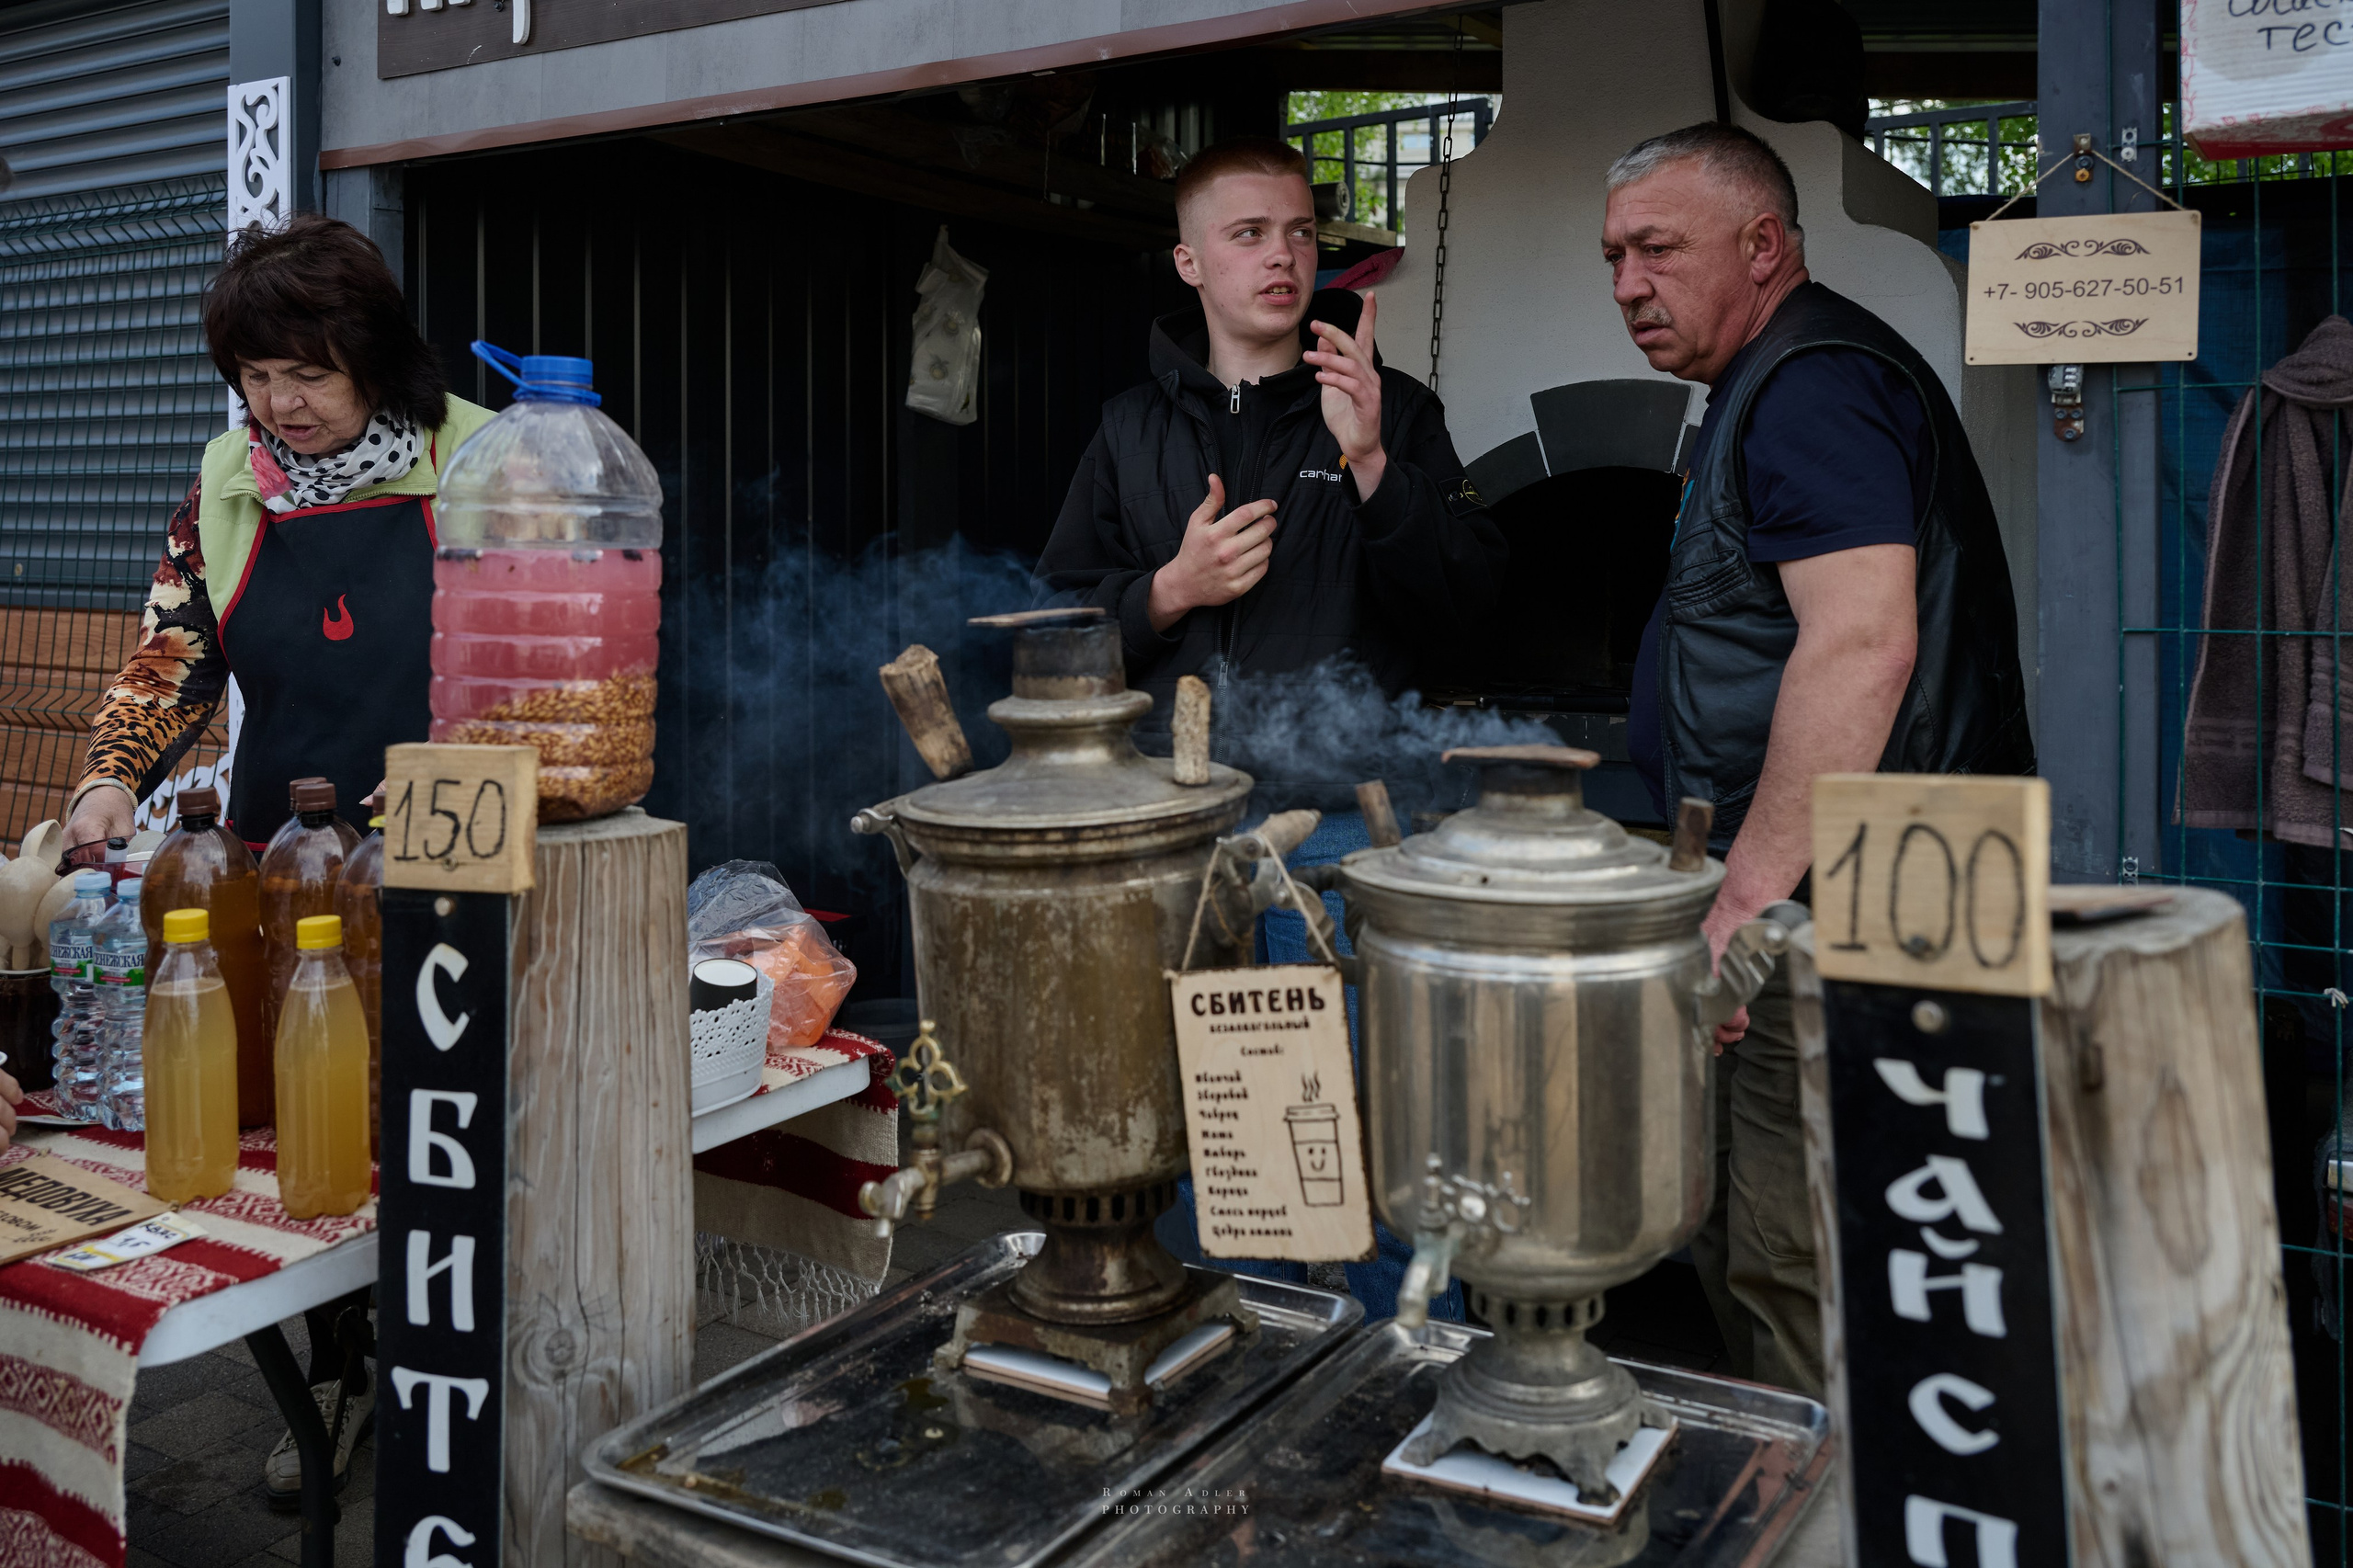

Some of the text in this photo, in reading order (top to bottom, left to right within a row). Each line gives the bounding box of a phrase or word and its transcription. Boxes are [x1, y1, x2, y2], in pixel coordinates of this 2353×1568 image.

[1984, 277, 2184, 300] +7- 905-627-50-51
[1300, 469, 1343, 483] carhar
[393, 778, 506, 860] 150
[1827, 822, 2025, 969] 100
[93, 952, 144, 968] ЕНЕЖСКАЯ
[1191, 987, 1325, 1017] СБИТЕНЬ
